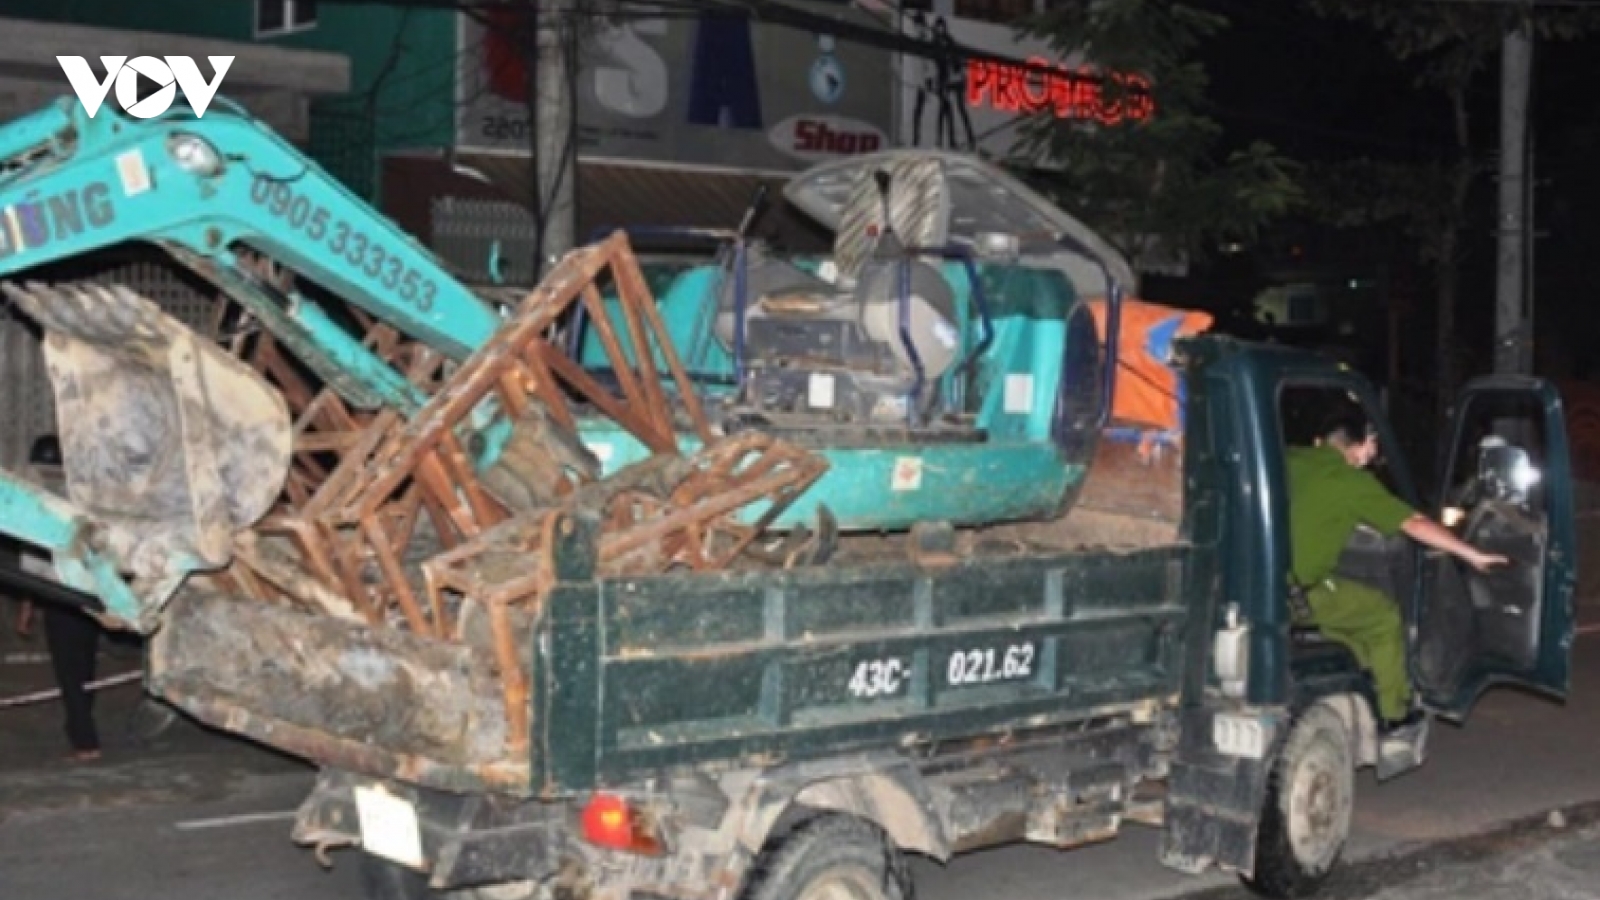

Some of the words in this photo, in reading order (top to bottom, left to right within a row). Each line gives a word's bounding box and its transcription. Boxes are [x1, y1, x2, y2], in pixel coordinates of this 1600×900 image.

[794, 119, 881, 155] Shop
[251, 174, 438, 312] 0905333353
[948, 642, 1035, 686] 021.62
